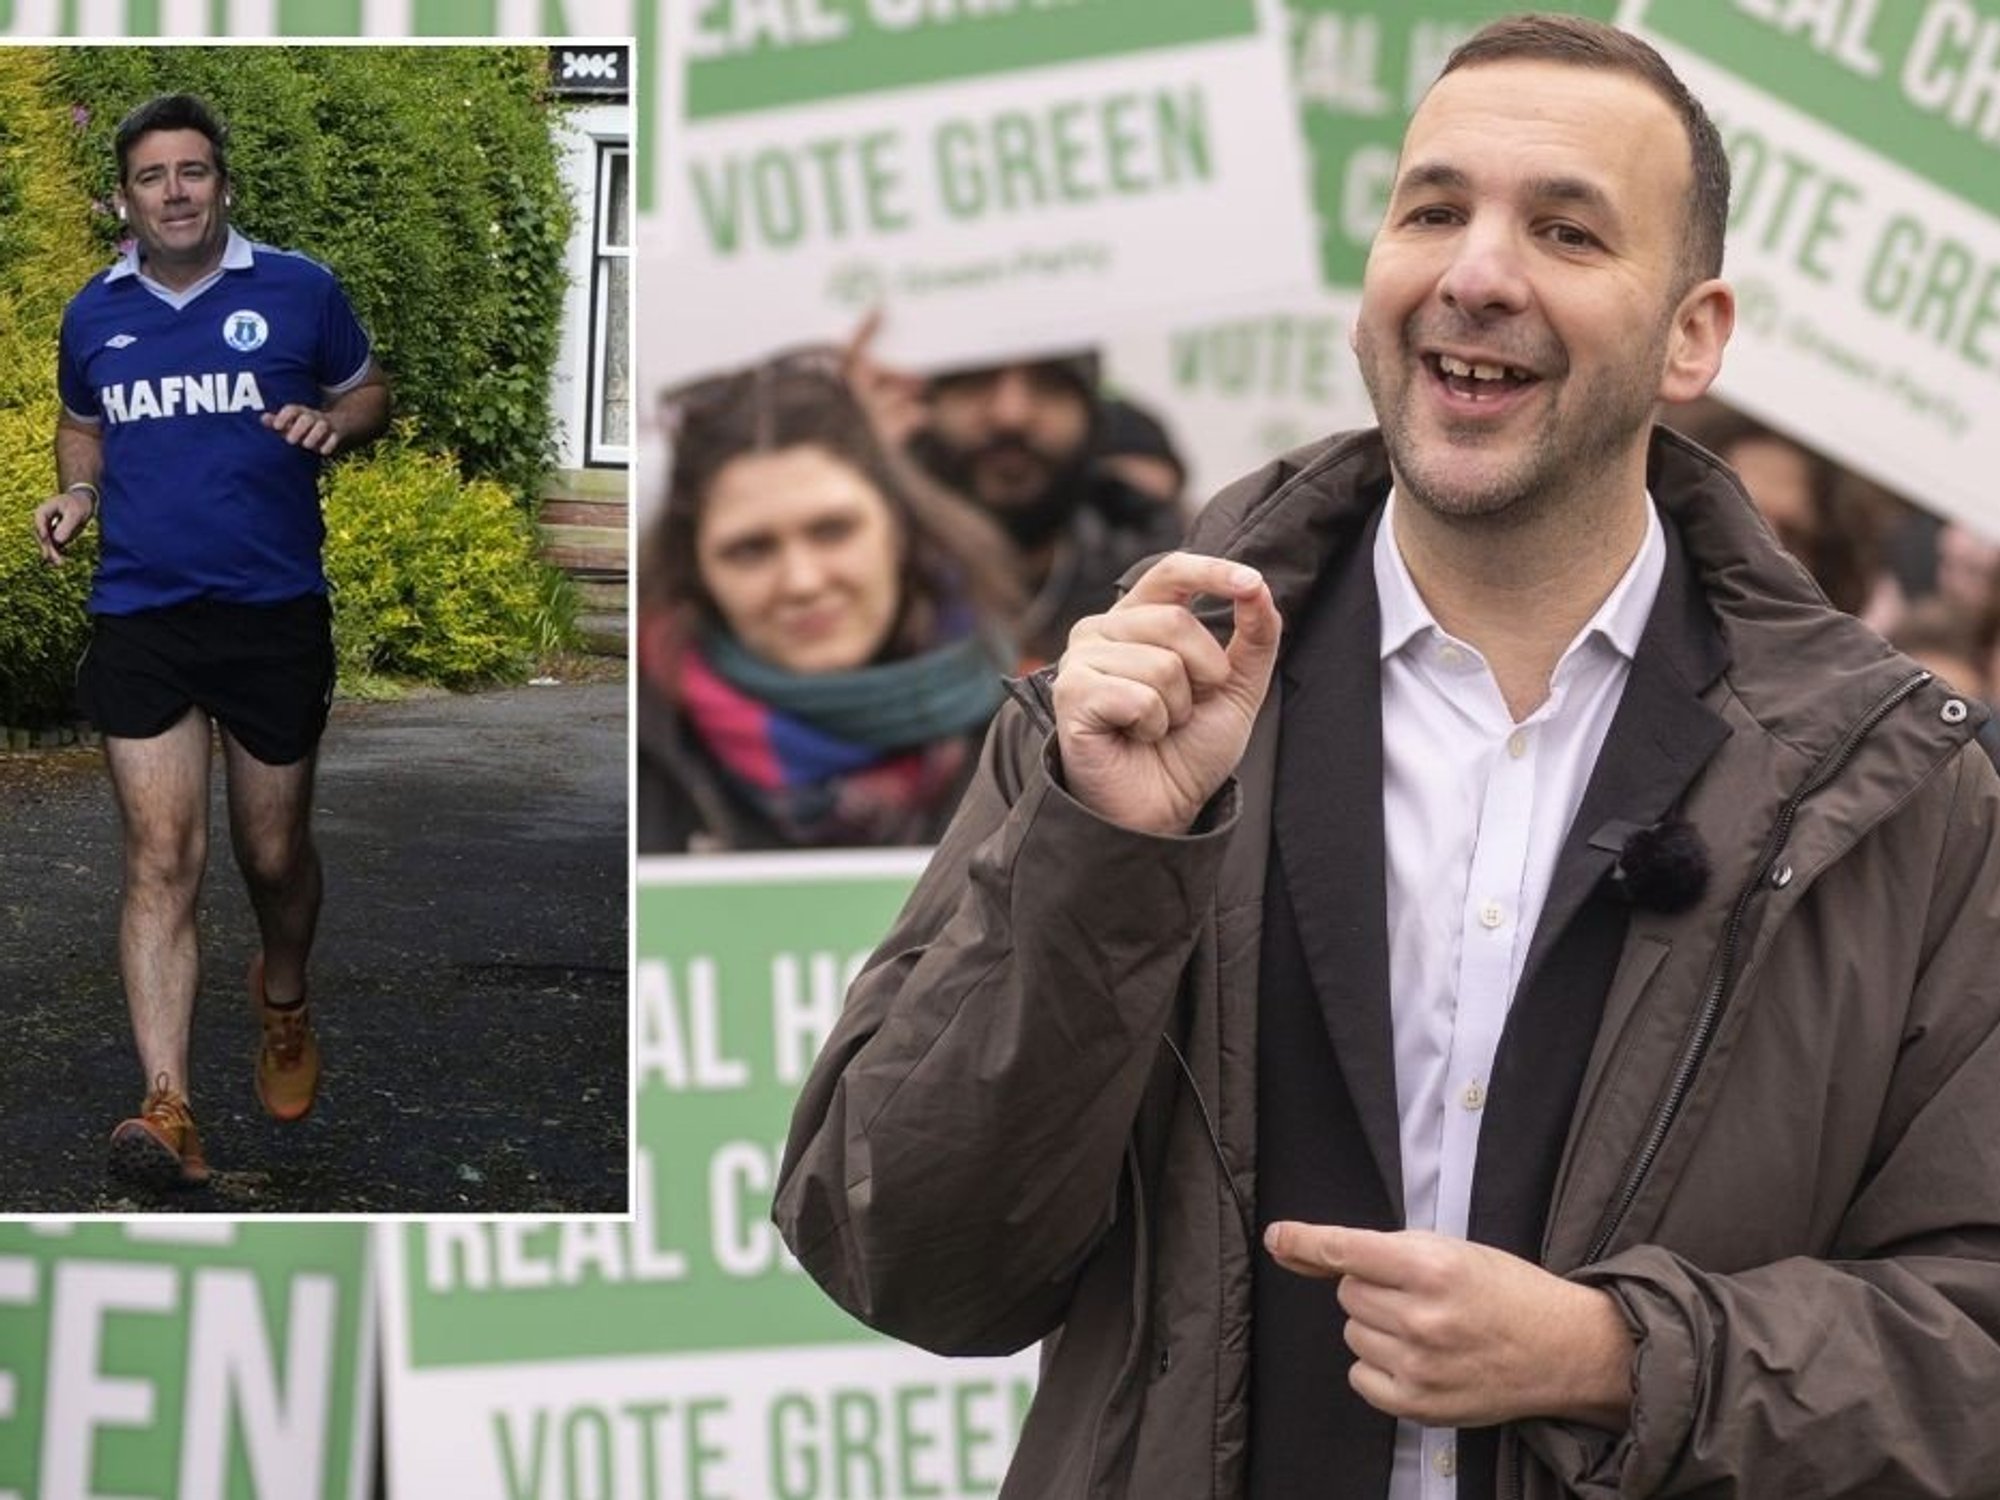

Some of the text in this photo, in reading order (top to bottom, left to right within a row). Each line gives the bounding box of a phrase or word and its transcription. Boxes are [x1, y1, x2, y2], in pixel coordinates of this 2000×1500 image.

[688, 130, 908, 256] VOTE
[934, 84, 1217, 222] GREEN
[1726, 120, 1863, 283] OTE
[102, 371, 265, 424] HAFNIA
[491, 1397, 731, 1500] VOTE
